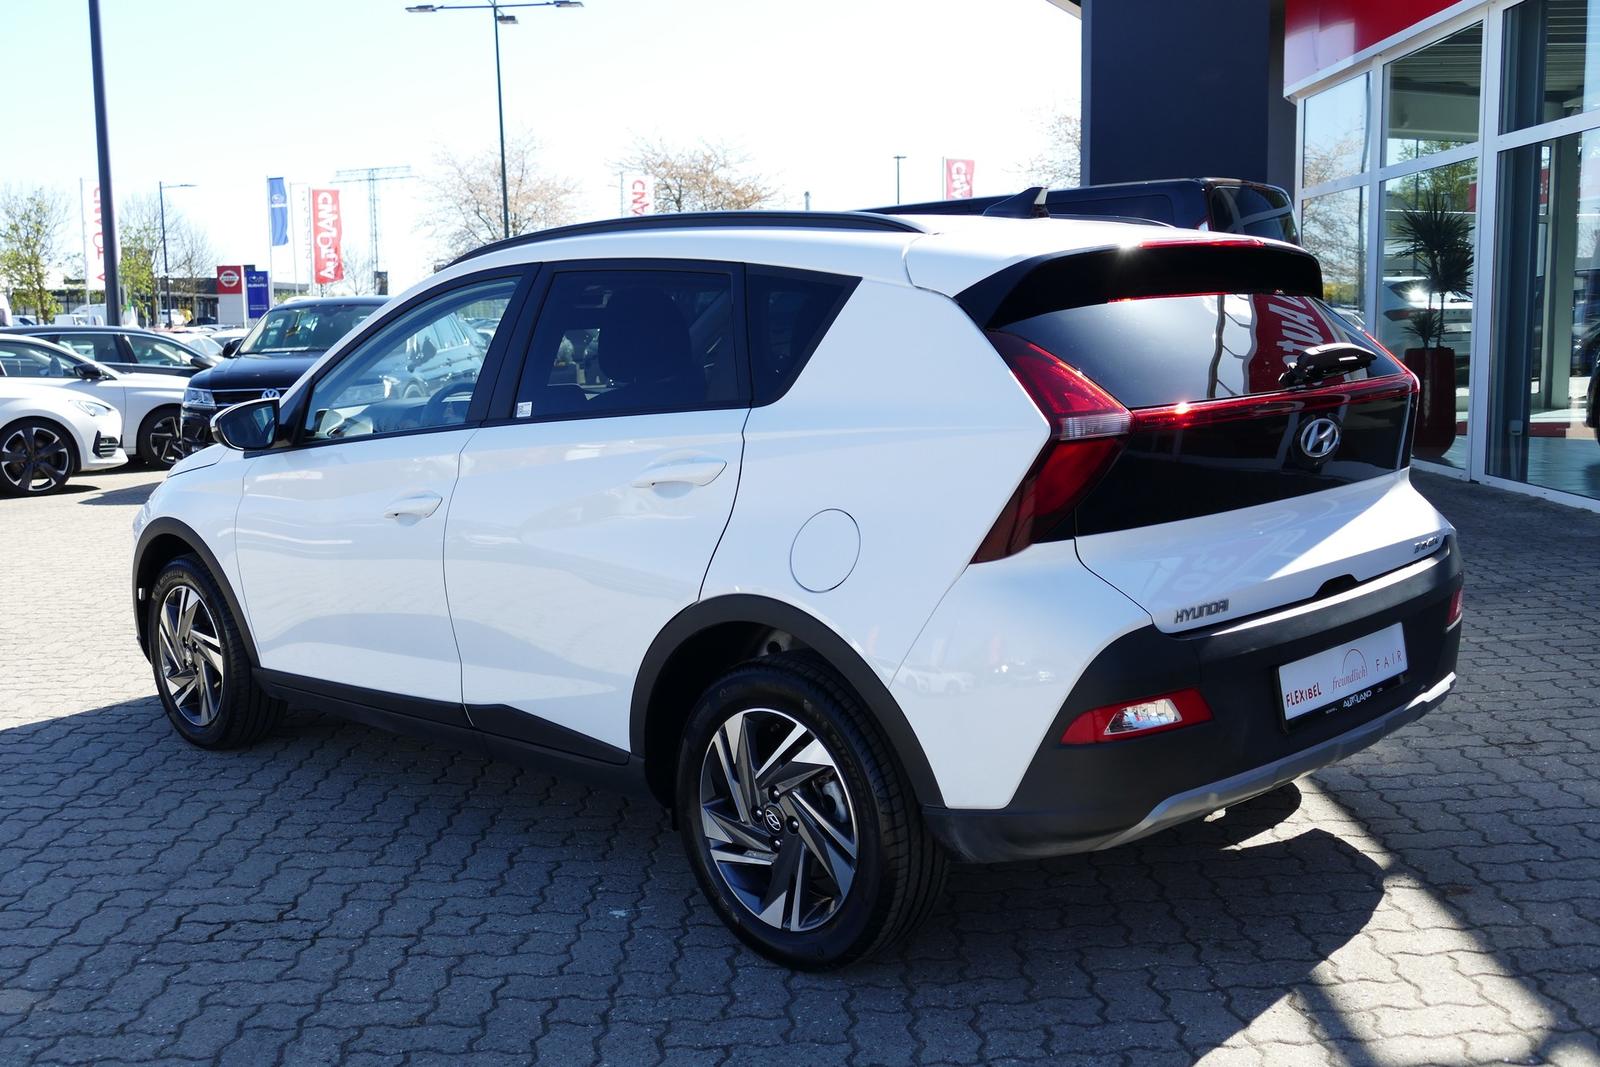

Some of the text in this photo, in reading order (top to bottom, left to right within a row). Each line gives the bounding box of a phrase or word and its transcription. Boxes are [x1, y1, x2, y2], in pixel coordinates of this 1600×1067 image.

[316, 191, 339, 280] AUTOLAND
[1174, 599, 1230, 624] HYUNDAI
[1285, 650, 1402, 708] FLEXIBEL freundlich FAIR
[1342, 690, 1372, 708] AUTOLAND
